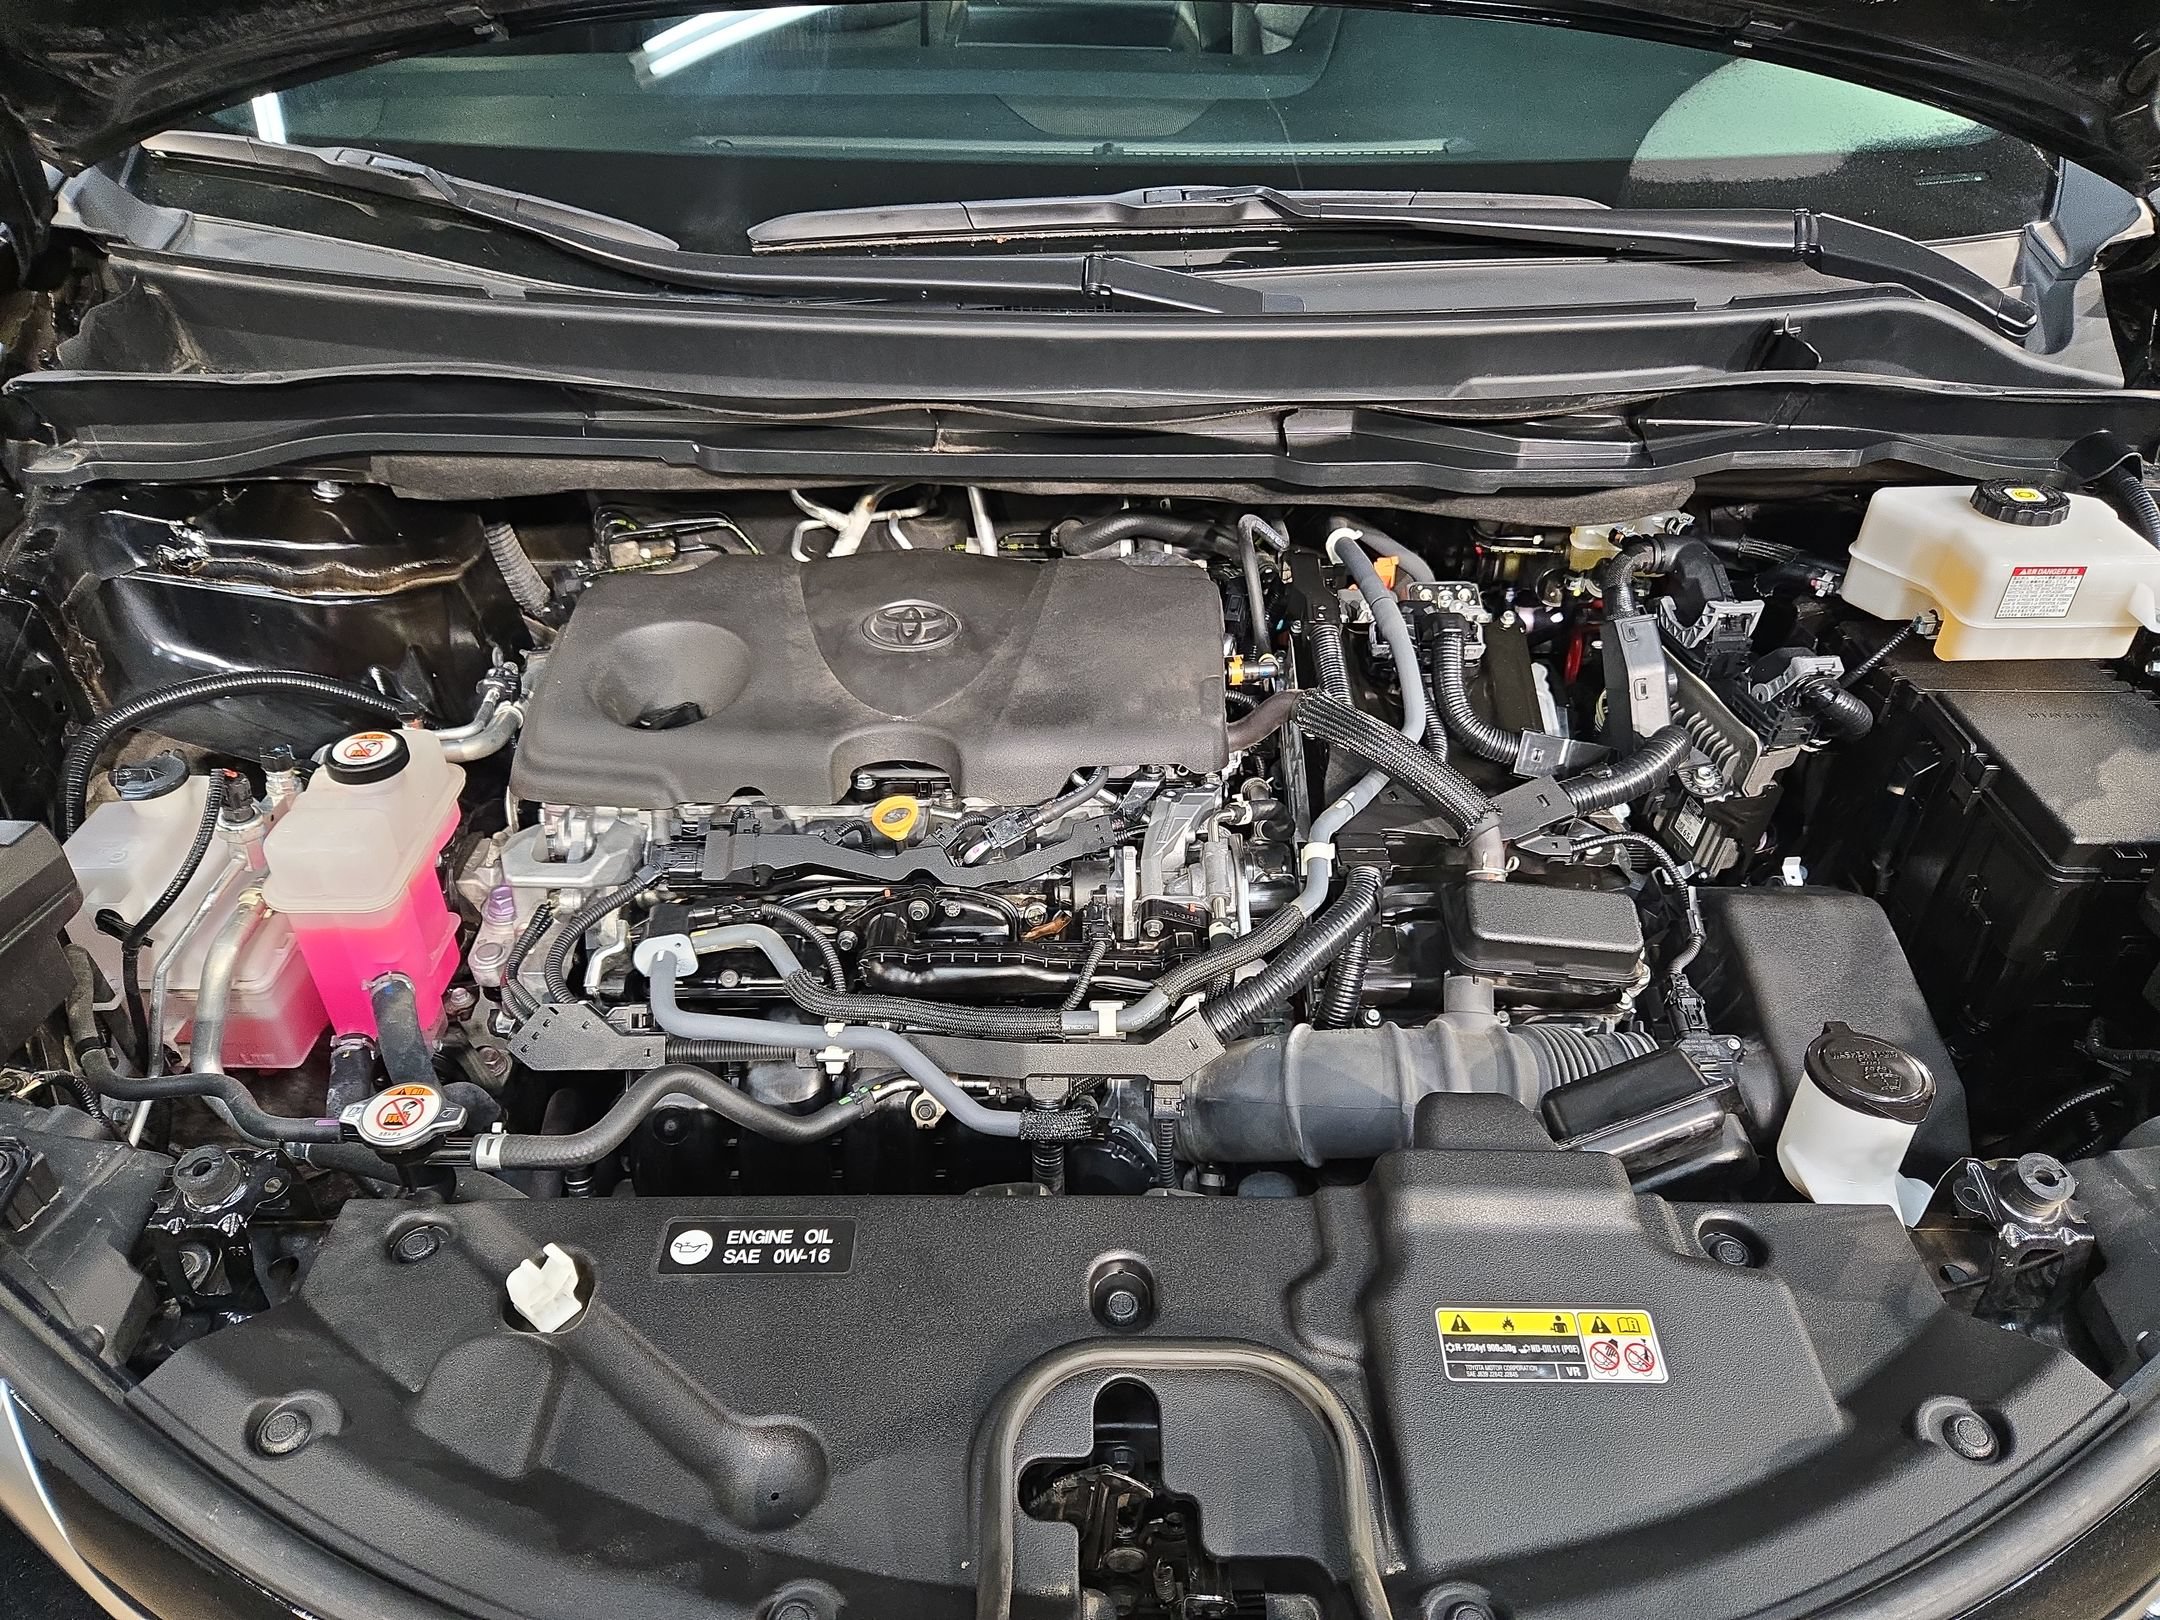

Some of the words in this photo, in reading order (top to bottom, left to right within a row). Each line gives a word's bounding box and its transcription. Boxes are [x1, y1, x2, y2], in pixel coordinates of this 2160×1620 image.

[726, 1229, 794, 1245] ENGINE
[804, 1229, 834, 1244] OIL
[722, 1249, 761, 1264] SAE
[773, 1248, 831, 1264] 0W-16
[1561, 1344, 1580, 1355] (POE)
[1503, 1364, 1538, 1372] CORPORATION
[1565, 1366, 1581, 1377] VR
